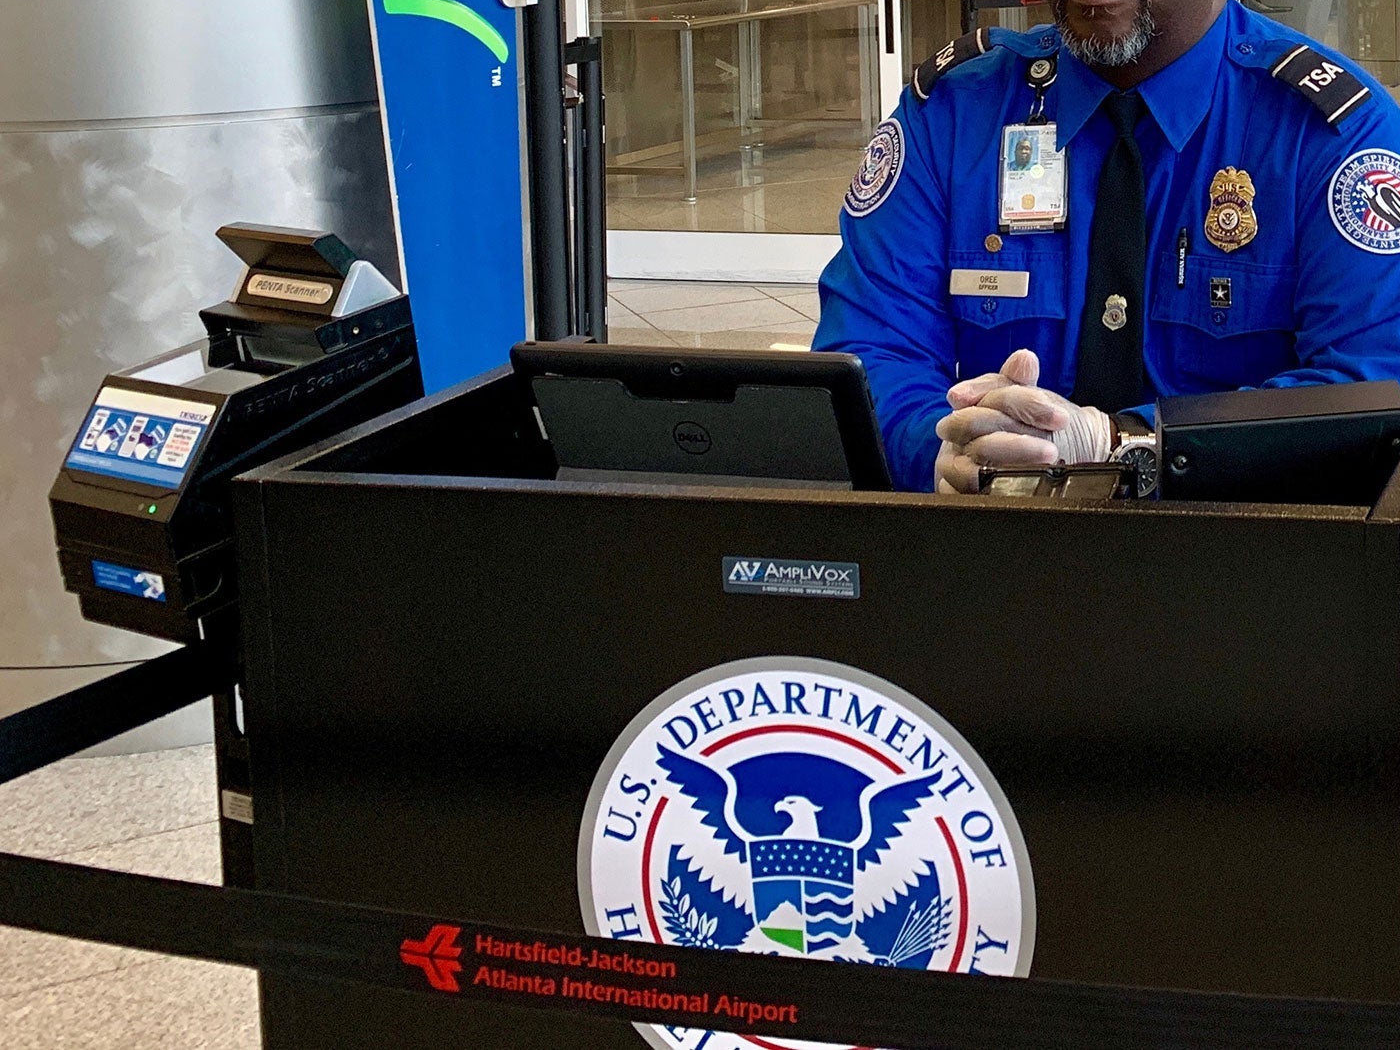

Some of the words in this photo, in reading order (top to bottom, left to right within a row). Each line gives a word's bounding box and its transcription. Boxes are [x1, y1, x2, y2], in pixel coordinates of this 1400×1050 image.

[1298, 60, 1344, 93] TSA
[1336, 160, 1360, 189] TEAM
[1351, 163, 1390, 183] SECURITY
[1335, 204, 1395, 248] INTEGRITY
[1343, 182, 1390, 239] TRANSPORTATION
[256, 280, 283, 292] PENTA
[284, 283, 319, 296] Scanner
[604, 773, 658, 842] U.S.
[661, 681, 975, 804] DEPARTMENT
[962, 810, 1007, 871] OF
[476, 934, 676, 978] Hartsfield-Jackson
[473, 965, 555, 996] Atlanta
[563, 977, 708, 1014] International
[714, 994, 798, 1025] Airport
